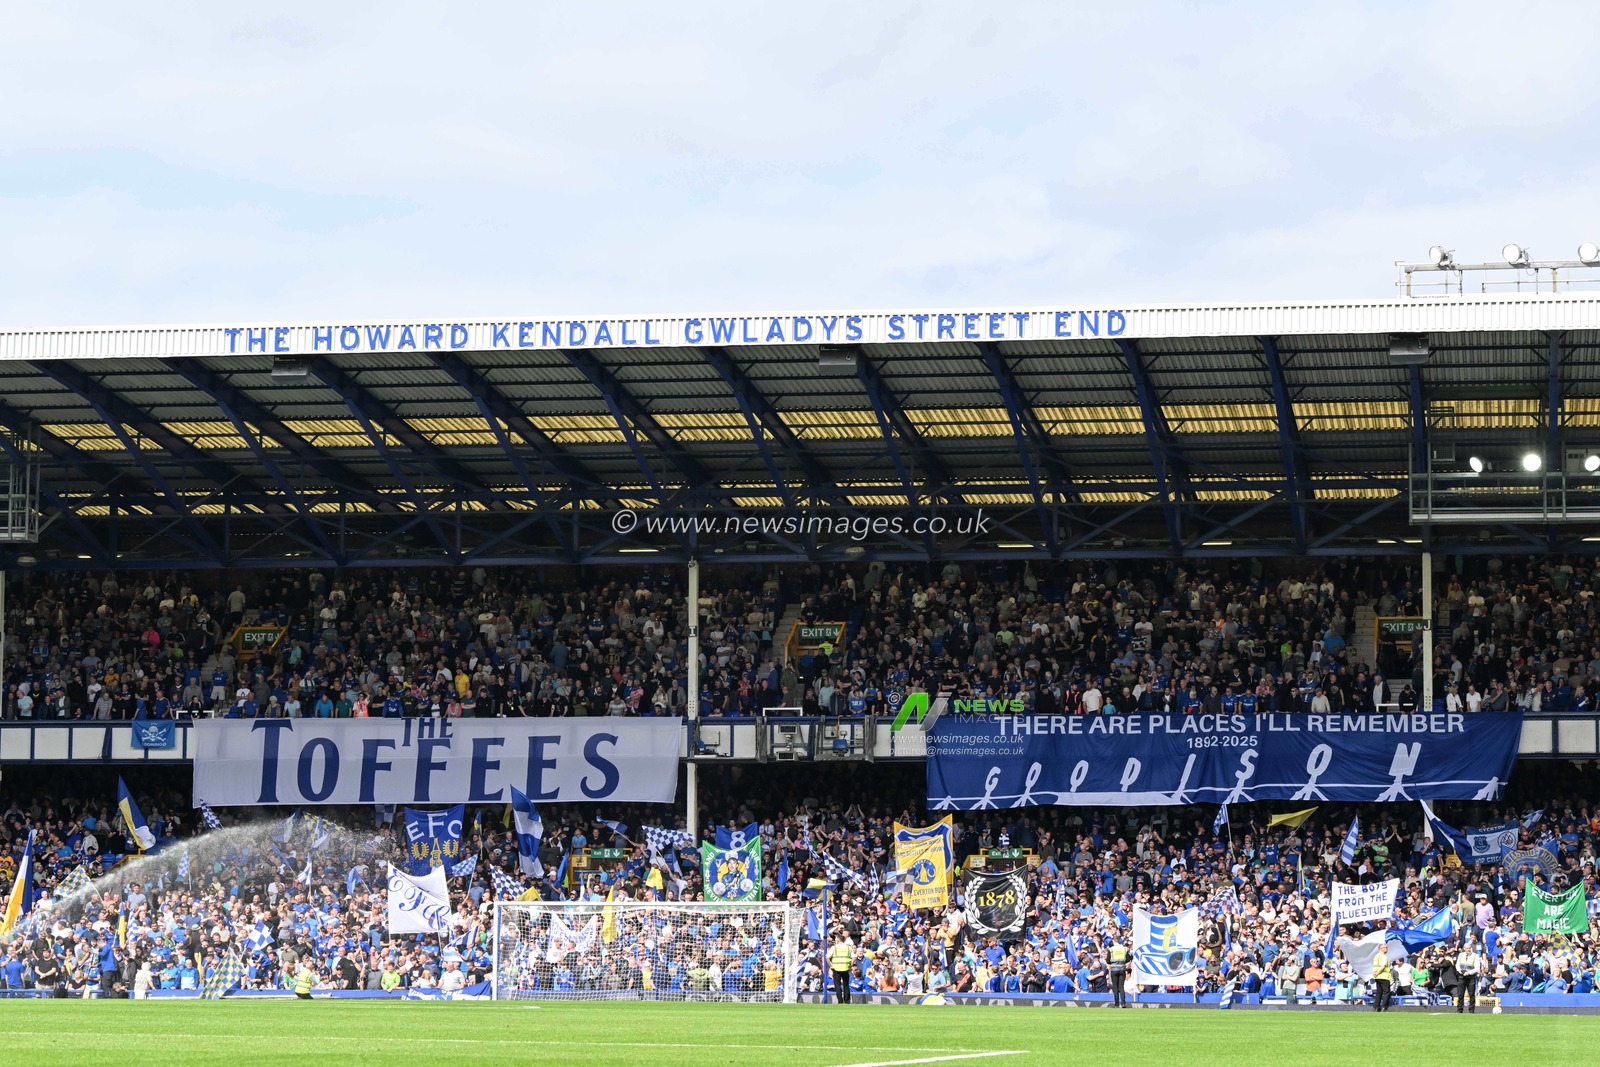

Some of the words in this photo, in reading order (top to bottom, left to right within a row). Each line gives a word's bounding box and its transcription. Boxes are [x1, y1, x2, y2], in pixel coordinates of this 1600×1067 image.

[225, 327, 290, 353] THE
[314, 324, 468, 351] HOWARD
[492, 320, 661, 348] KENDALL
[684, 315, 863, 344] GWLADYS
[887, 313, 1030, 341] STREET
[1055, 311, 1127, 336] END
[801, 628, 824, 637] EXIT
[401, 717, 454, 747] THE
[994, 715, 1084, 736] THERE
[1088, 714, 1142, 735] ARE
[1149, 714, 1246, 734] PLACES
[1255, 714, 1301, 732] I'LL
[1307, 714, 1465, 733] REMEMBER
[1186, 735, 1258, 749] 1892-2025
[251, 719, 620, 803] TOFFEES
[406, 812, 462, 842] EFC
[730, 830, 746, 851] 8
[978, 890, 1014, 908] 1878
[1338, 886, 1356, 895] THE
[1338, 896, 1364, 908] FROM
[1370, 892, 1388, 902] THE
[1336, 904, 1392, 920] BLUESTUFF
[1544, 905, 1564, 916] ARE
[1536, 918, 1570, 930] MAGIC
